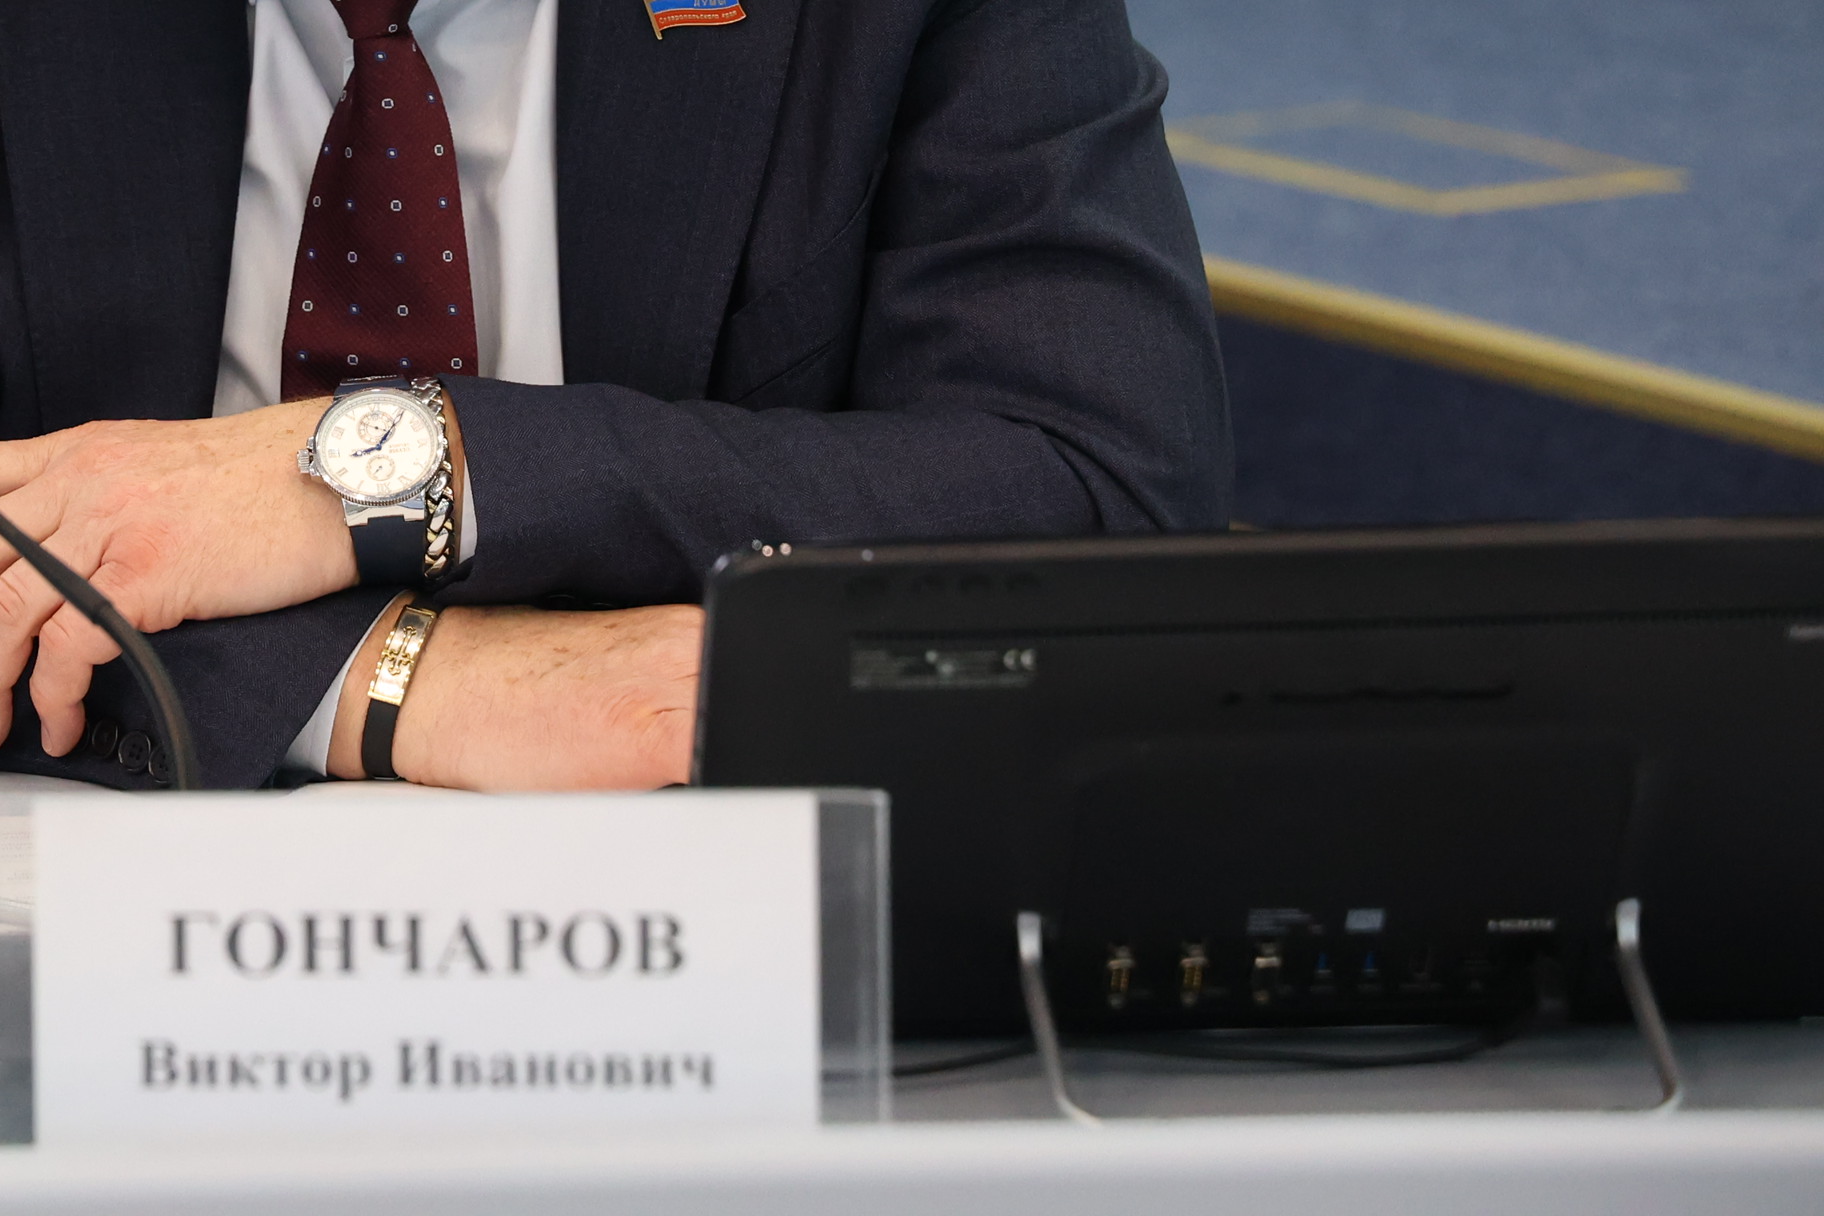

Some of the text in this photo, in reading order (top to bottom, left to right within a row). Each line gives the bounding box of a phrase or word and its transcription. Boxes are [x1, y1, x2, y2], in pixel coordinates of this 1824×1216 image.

[168, 910, 687, 978] ГОНЧАРОВ
[138, 1038, 717, 1103] Виктор Иванович
